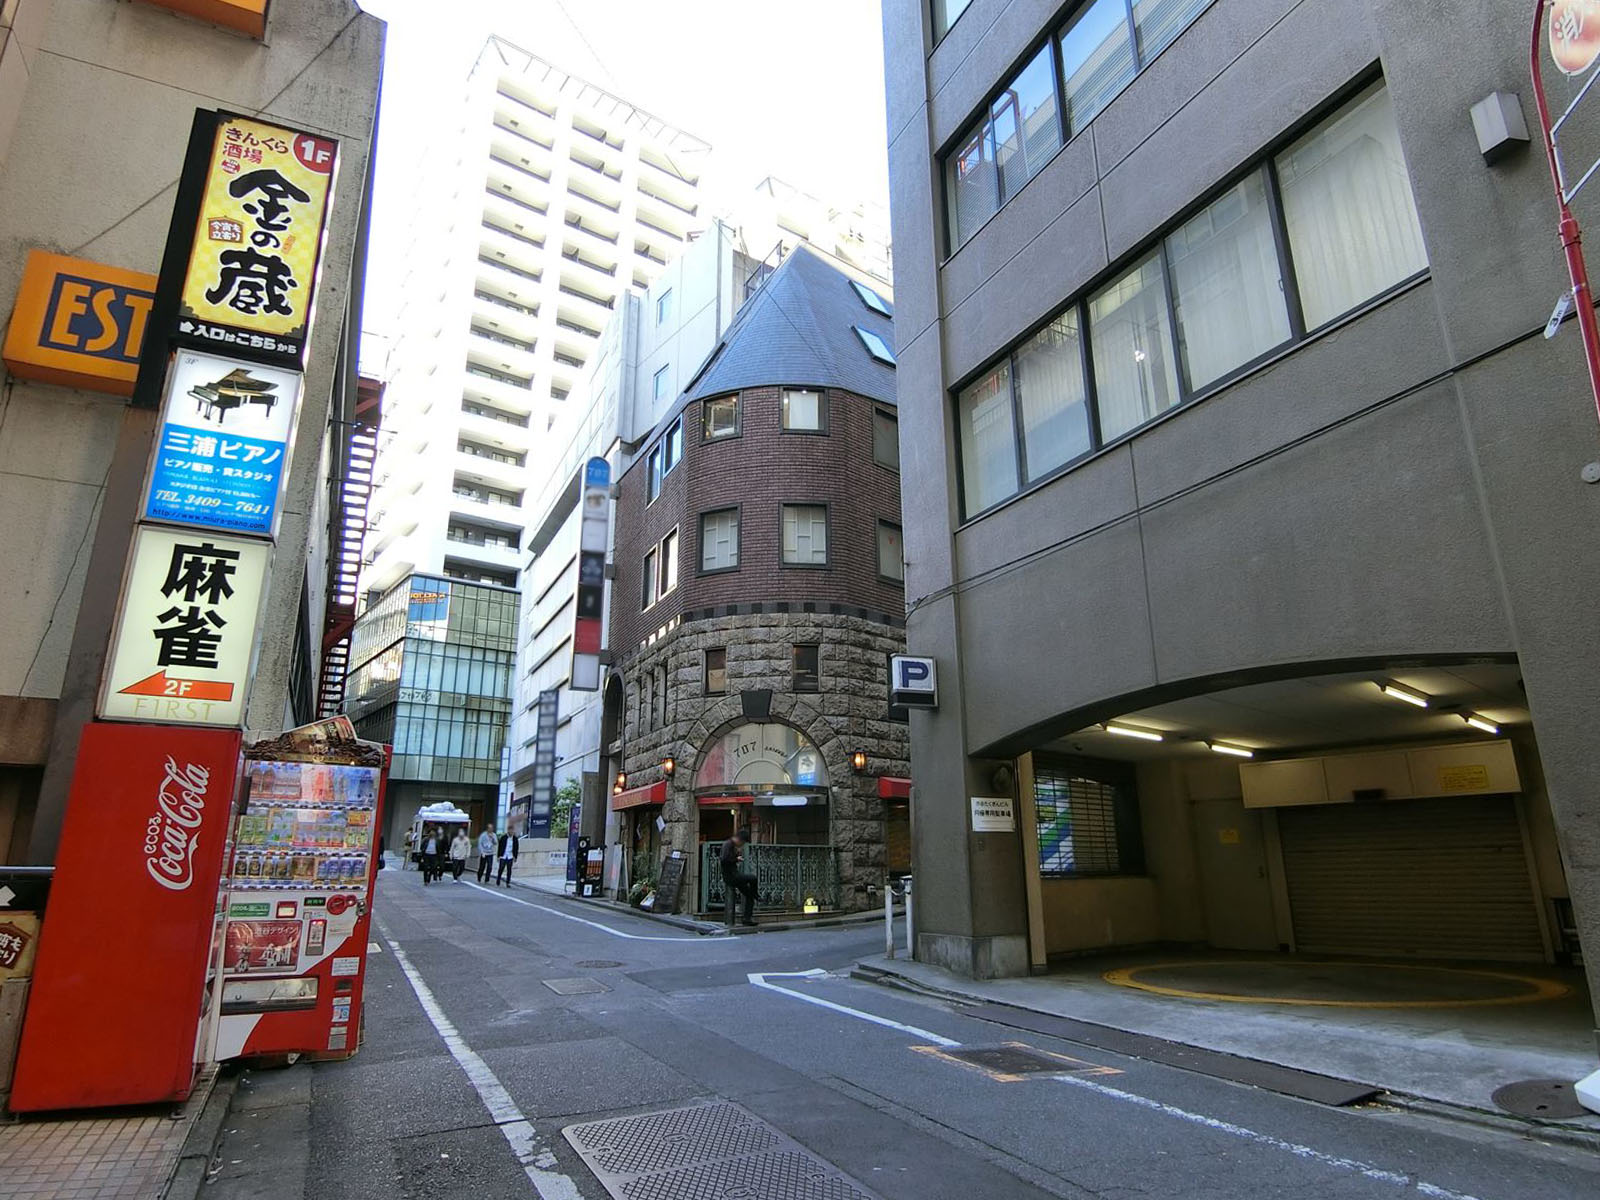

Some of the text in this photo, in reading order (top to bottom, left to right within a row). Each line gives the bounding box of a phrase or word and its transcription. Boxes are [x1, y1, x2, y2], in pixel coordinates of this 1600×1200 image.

[222, 141, 263, 165] 酒場
[226, 127, 289, 154] きんくら
[301, 139, 331, 164] 1F
[205, 168, 311, 316] 金の蔵
[193, 324, 298, 354] 入口はこちらから
[164, 431, 282, 465] 三浦ピアノ
[152, 542, 241, 670] 麻雀
[163, 679, 194, 696] 2F
[901, 660, 929, 688] P
[133, 697, 217, 721] FIRST
[733, 740, 757, 758] 707
